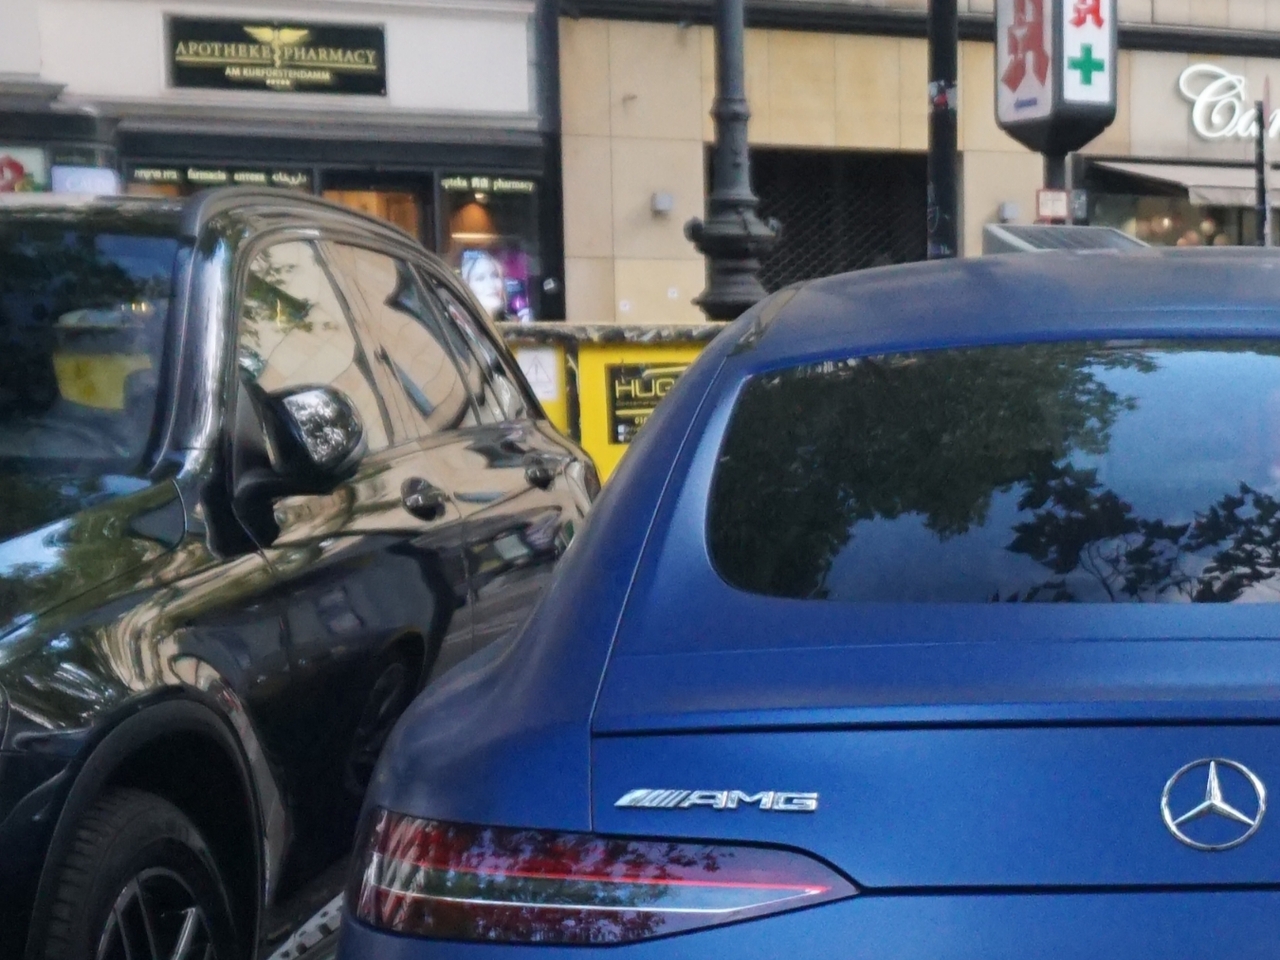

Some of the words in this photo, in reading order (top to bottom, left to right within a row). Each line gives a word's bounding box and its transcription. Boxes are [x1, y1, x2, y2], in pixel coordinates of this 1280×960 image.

[176, 41, 271, 58] APOTHEKE
[283, 47, 377, 64] PHARMACY
[225, 67, 240, 77] AM
[493, 179, 534, 191] pharmacy
[682, 790, 818, 811] AMG
